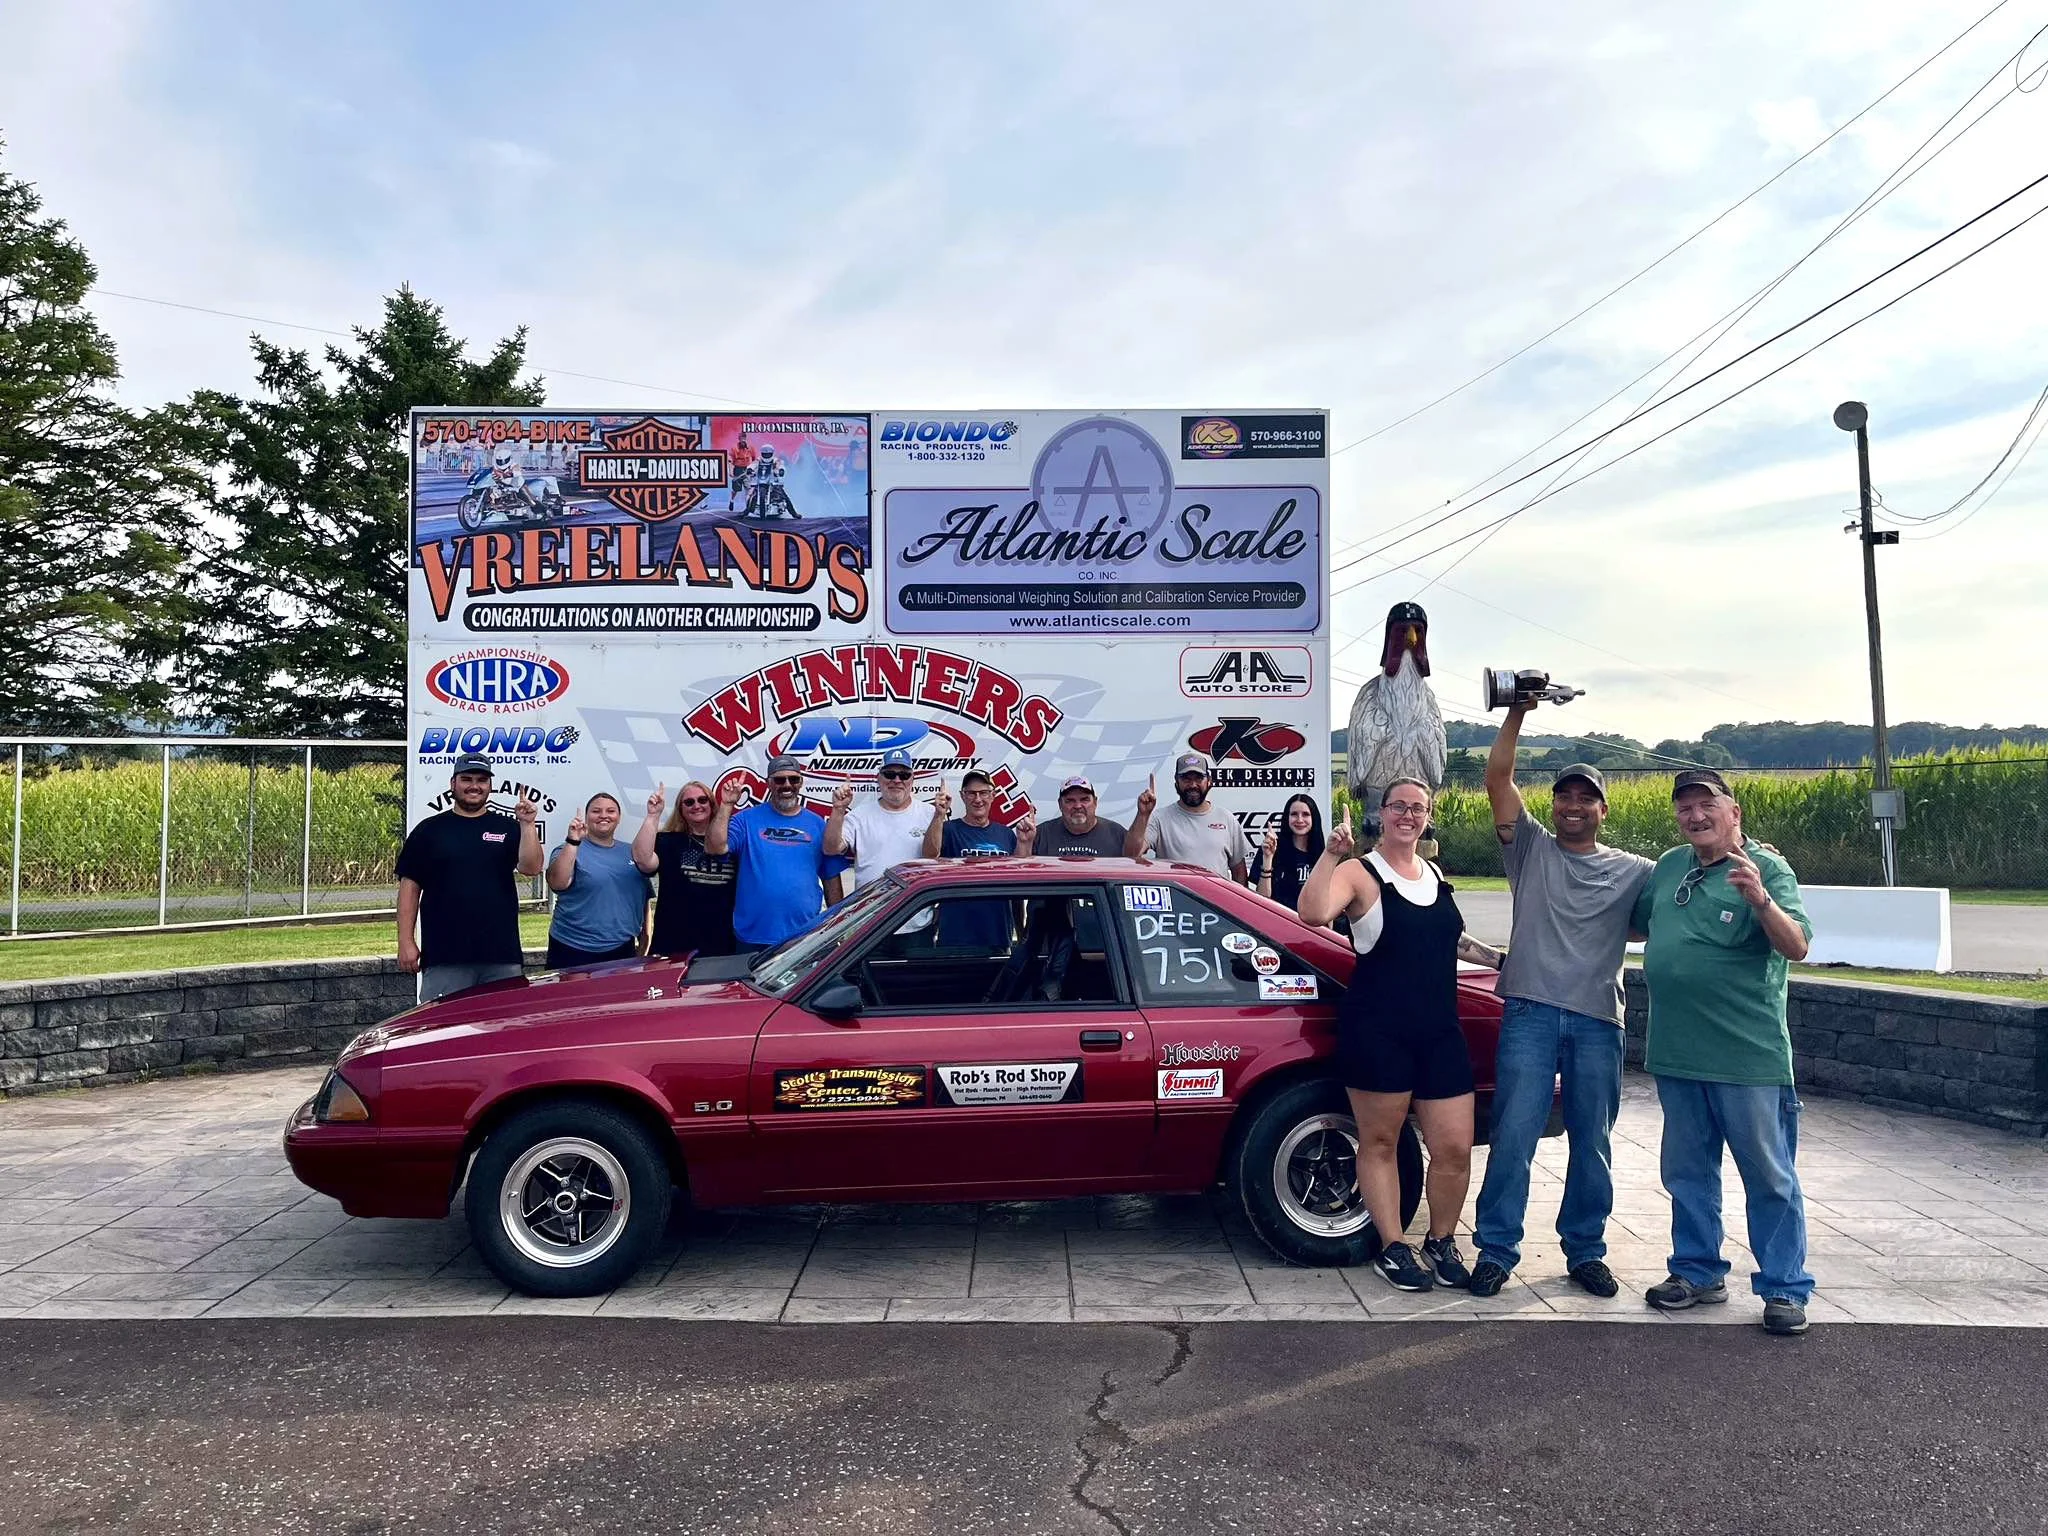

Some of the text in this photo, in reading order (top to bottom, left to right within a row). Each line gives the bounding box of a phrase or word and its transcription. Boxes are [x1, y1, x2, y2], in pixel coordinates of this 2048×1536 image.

[424, 420, 592, 443] 570-784-BIKE
[742, 422, 849, 435] BLOOMSBURG, PA.
[880, 421, 1015, 442] BIONDO
[1250, 430, 1322, 441] 570-966-3100
[617, 428, 687, 450] MOTOR
[881, 443, 1012, 452] RACING PRODUCTS, INC.
[908, 452, 986, 461] 1-800-332-1320
[587, 458, 720, 480] HARLEY-DAVIDSON
[620, 487, 691, 516] CYCLES
[903, 498, 1308, 563] Atlantic Scale
[417, 523, 869, 622] VREELAND'S
[905, 589, 1300, 606] A Multi-Dimensional Weighing Solution and Calibration Service Provider
[471, 607, 815, 628] CONGRATULATIONS ON ANOTHER CHAMPIONSHIP
[1009, 613, 1191, 627] www.atlanticscale.com
[449, 648, 548, 665] CHAMPIONSHIP
[450, 659, 550, 702] NHRA
[1189, 684, 1293, 693] AUTO STORE
[449, 697, 547, 714] DRAG RACING
[682, 643, 1063, 755] WINNERS
[419, 727, 572, 753] BIONDO
[419, 756, 459, 765] RACIN
[546, 755, 571, 764] INC.
[1244, 769, 1315, 780] DESIGNS
[1132, 887, 1161, 905] ND
[1135, 912, 1219, 940] DEEP
[1142, 947, 1224, 986] 7.51
[1159, 1040, 1240, 1066] Hoosier
[780, 1069, 919, 1091] Scott's Transmission
[950, 1068, 1067, 1085] Rob's Rod Shop
[806, 1086, 861, 1098] Center,
[694, 1100, 732, 1112] 5.0
